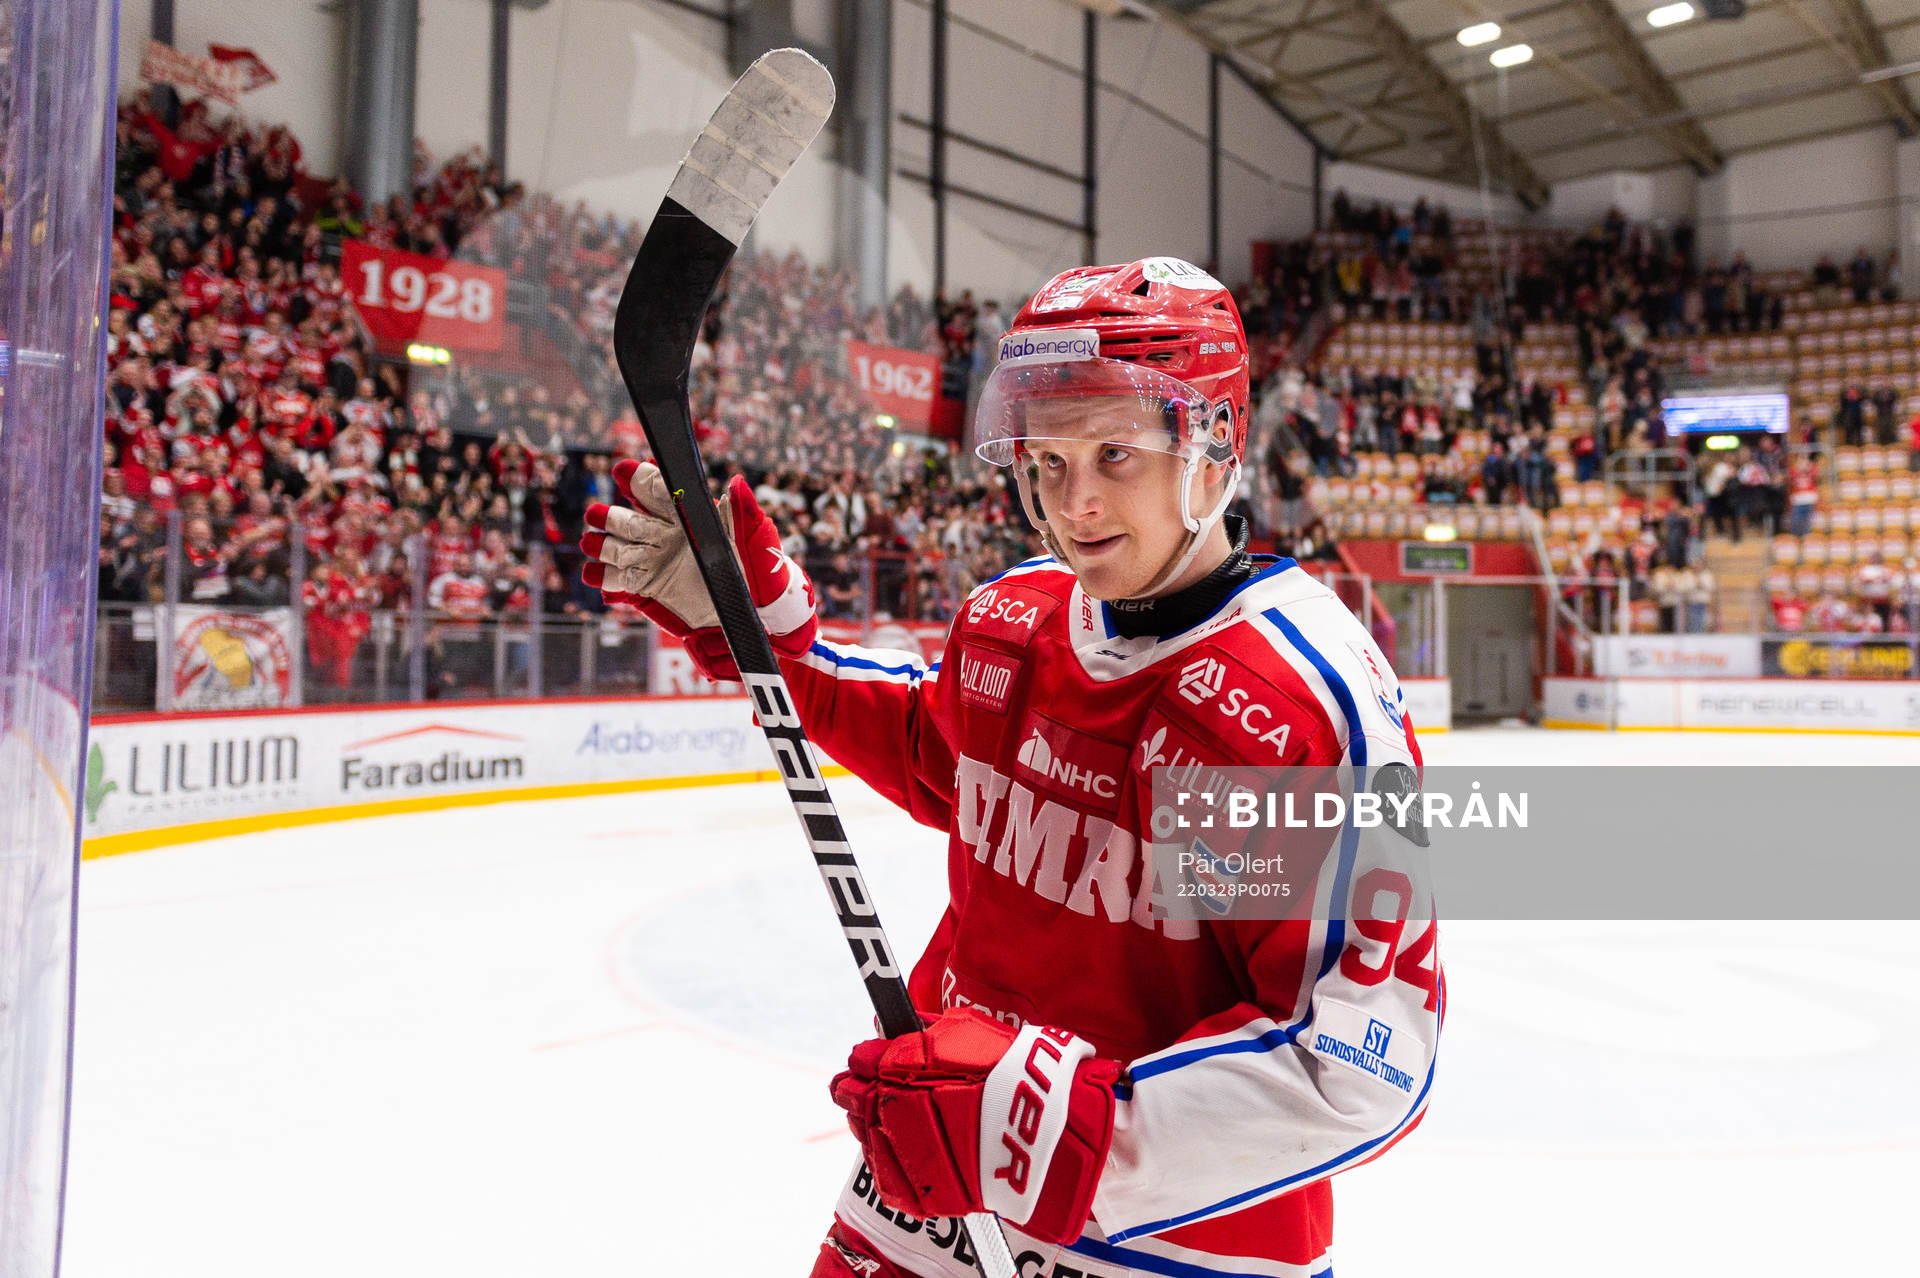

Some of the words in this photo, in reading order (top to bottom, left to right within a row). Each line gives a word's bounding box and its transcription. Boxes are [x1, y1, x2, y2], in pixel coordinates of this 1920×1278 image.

[359, 259, 493, 324] 1928
[1000, 337, 1098, 361] Aiabenergy
[856, 356, 932, 400] 1962
[989, 598, 1040, 631] SCA
[1082, 593, 1094, 632] UER
[1110, 599, 1155, 612] UER
[964, 659, 1011, 699] LILIUM
[579, 722, 748, 757] Aiabenergy
[1218, 687, 1292, 758] SCA
[129, 734, 299, 796] LILIUM
[341, 750, 524, 791] Faradium
[1050, 757, 1117, 798] NHC
[742, 672, 900, 981] BAUER
[1340, 867, 1437, 1013] 94
[1365, 1021, 1390, 1057] ST
[1315, 1034, 1380, 1075] SUNDSVALLS
[1380, 1061, 1415, 1093] TIDNING
